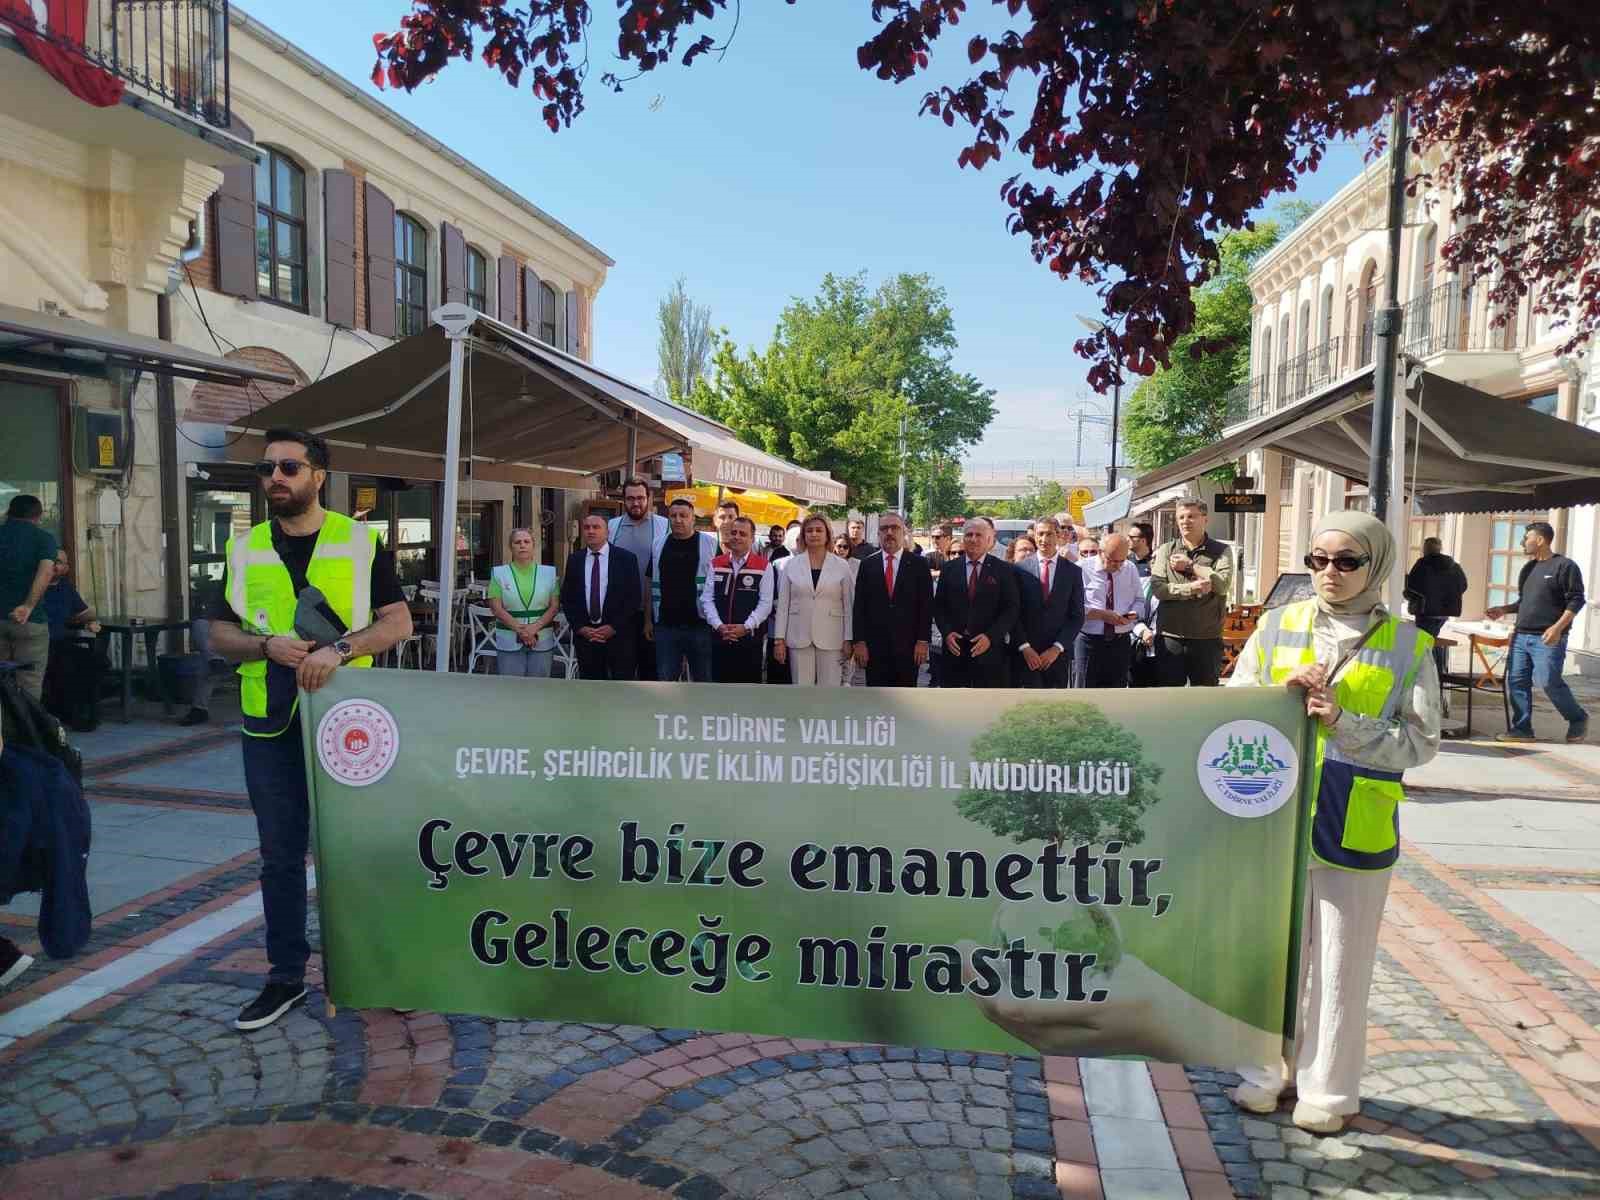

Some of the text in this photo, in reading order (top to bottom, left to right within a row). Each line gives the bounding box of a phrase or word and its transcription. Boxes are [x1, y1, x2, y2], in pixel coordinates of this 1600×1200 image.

[654, 713, 896, 747] T.C. EDİRNE VALİLİĞİ
[455, 746, 1130, 796] ÇEVRE, ŞEHİRCİLİK VE İKLİM DEĞİŞİKLİĞİ İL MÜDÜRLÜĞÜ
[417, 818, 1173, 918] Çevre bize emanettir,
[469, 908, 1111, 1002] Geleceğe mirastır.
